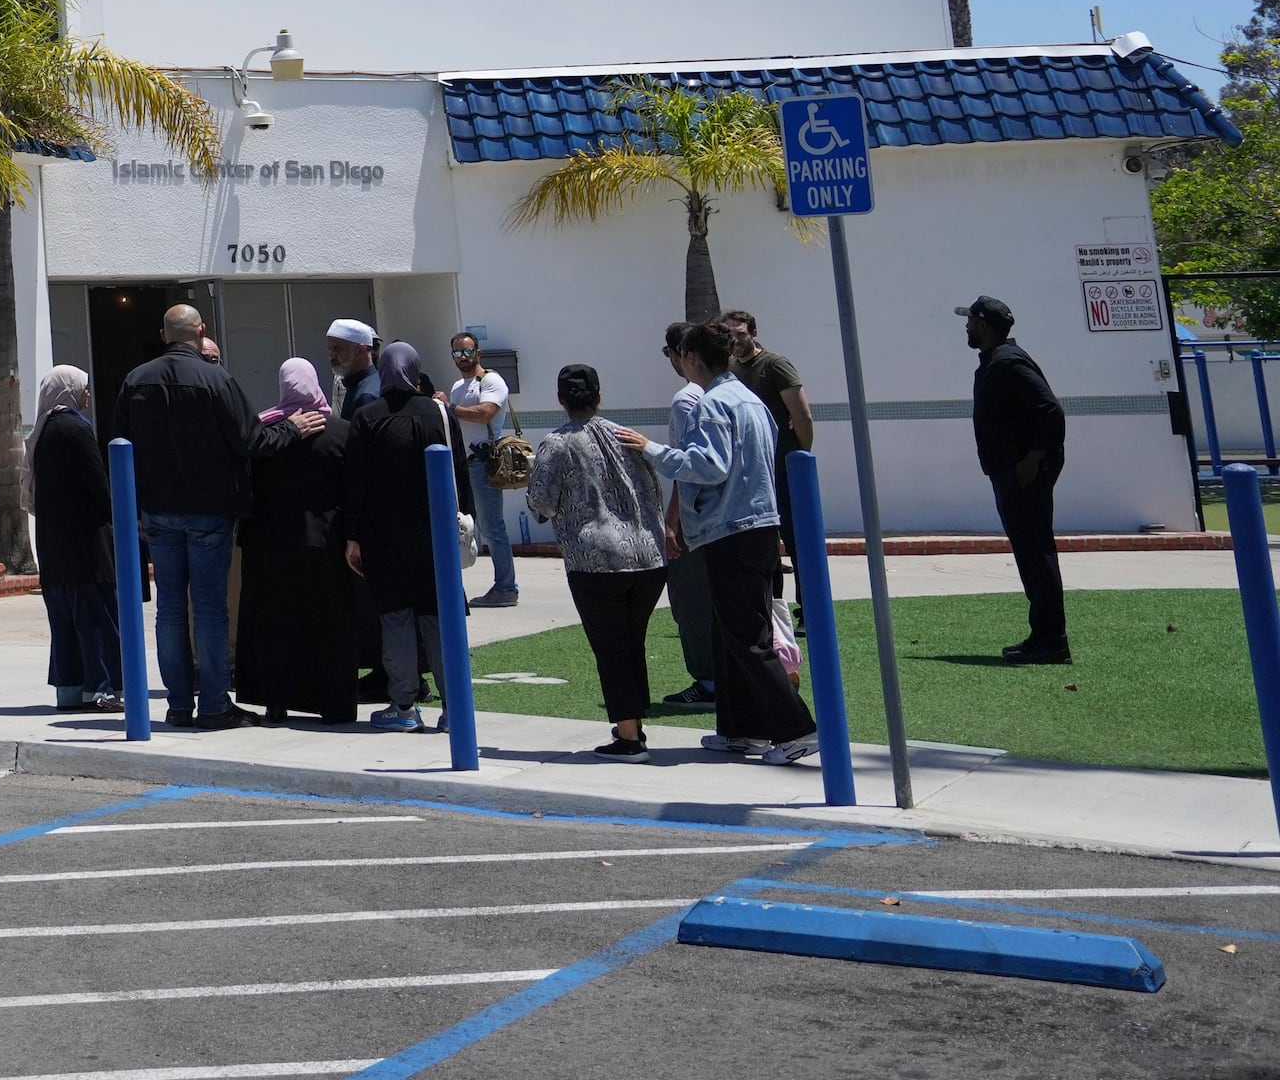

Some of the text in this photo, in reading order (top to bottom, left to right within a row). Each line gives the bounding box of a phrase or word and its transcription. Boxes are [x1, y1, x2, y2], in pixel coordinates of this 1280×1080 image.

[112, 159, 385, 184] Islamic Cnter of San Diego
[790, 156, 867, 182] PARKING
[807, 184, 853, 209] ONLY
[227, 244, 287, 263] 7050
[1079, 247, 1130, 256] No smoking on
[1106, 258, 1131, 267] property
[1090, 300, 1109, 326] NO
